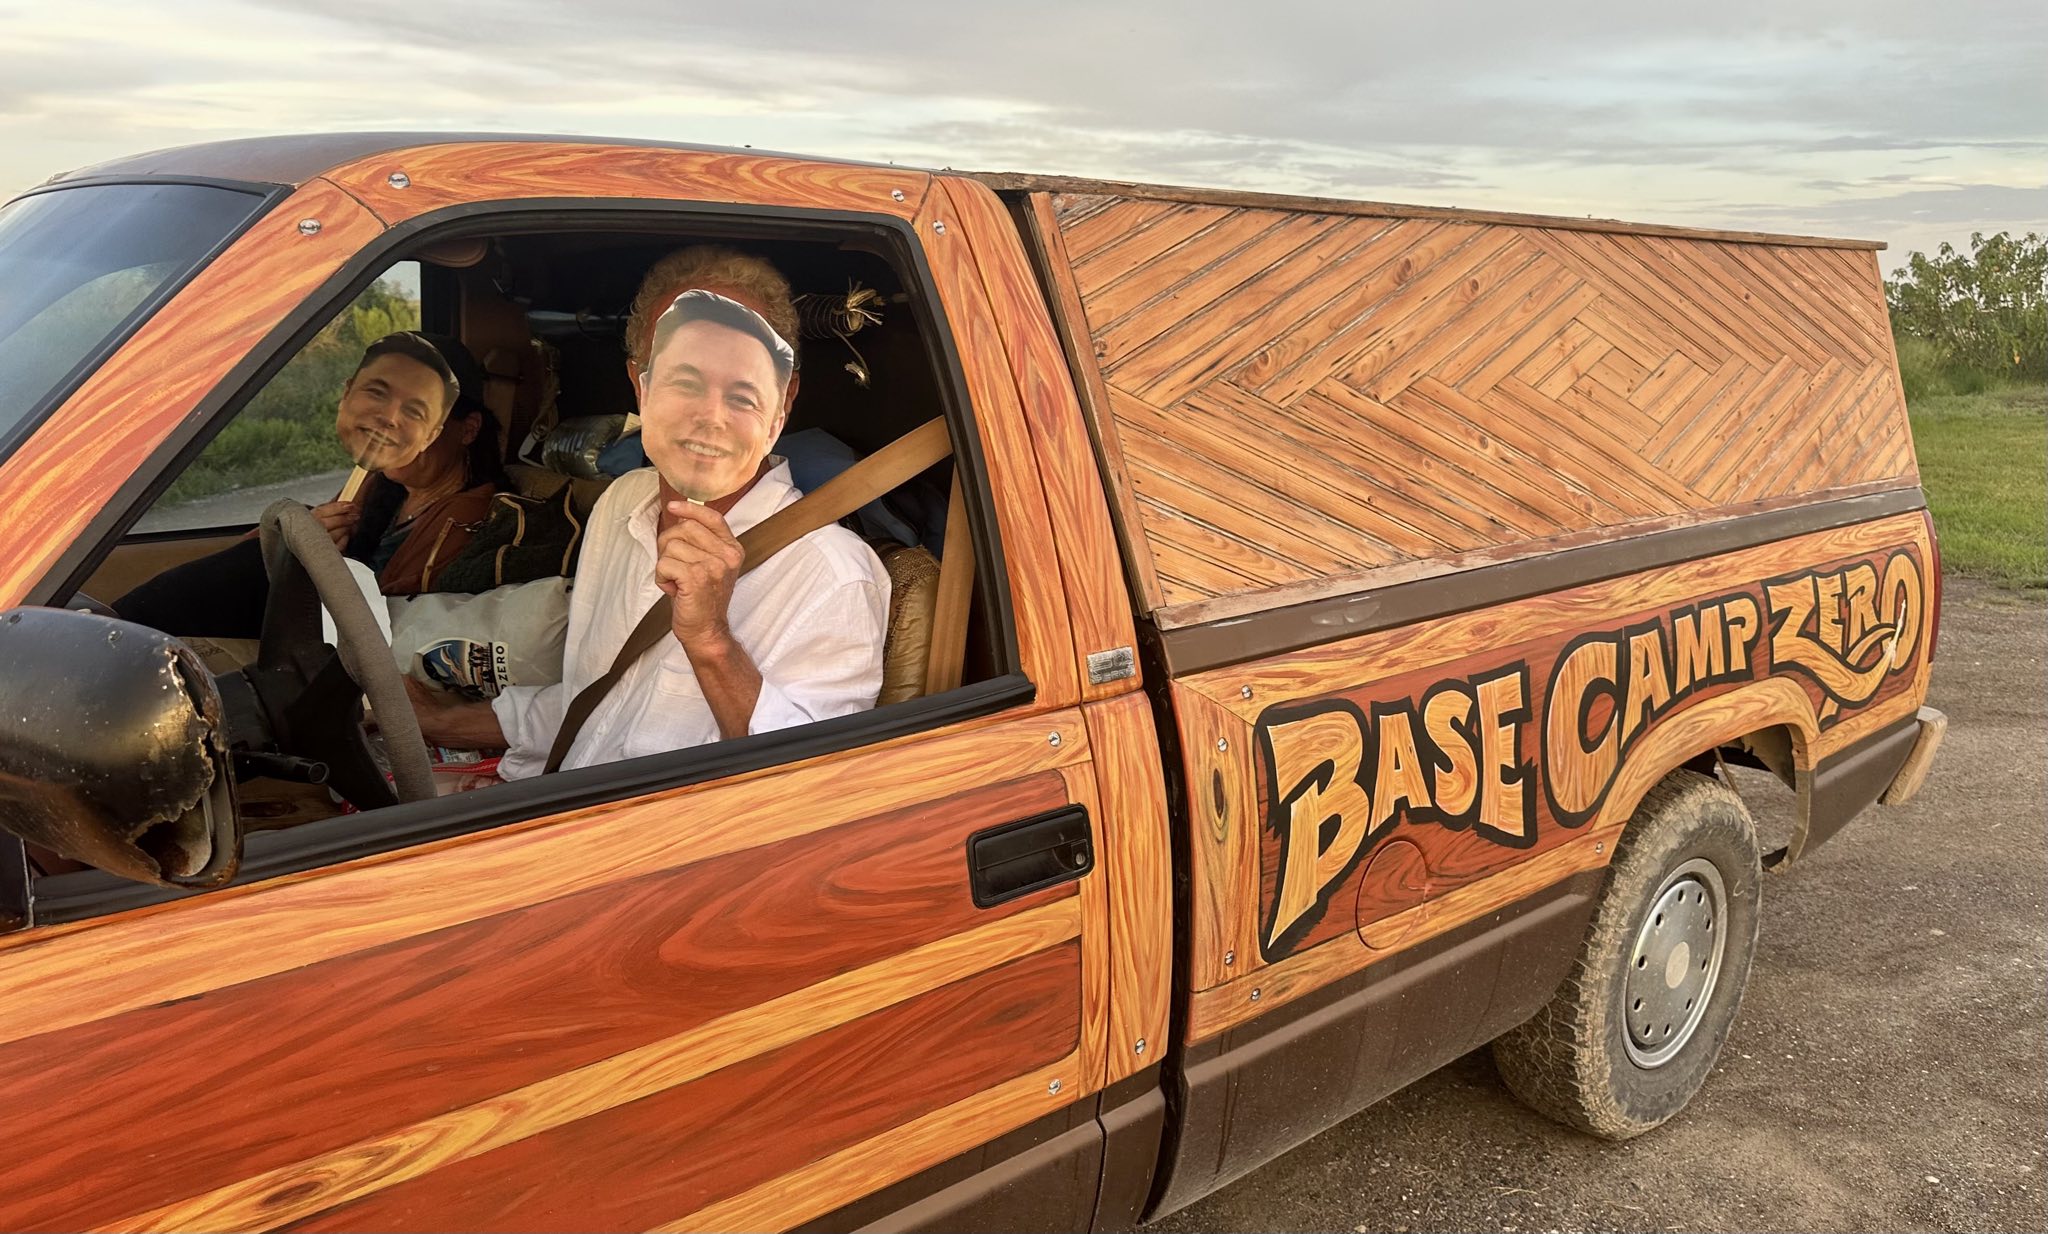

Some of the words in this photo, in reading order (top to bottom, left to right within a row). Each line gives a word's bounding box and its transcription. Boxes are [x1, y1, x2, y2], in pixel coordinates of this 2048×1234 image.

[495, 645, 509, 682] ZERO
[1263, 668, 1529, 952] BASE
[1546, 597, 1758, 816] CAMP
[1763, 550, 1924, 718] ZERO
